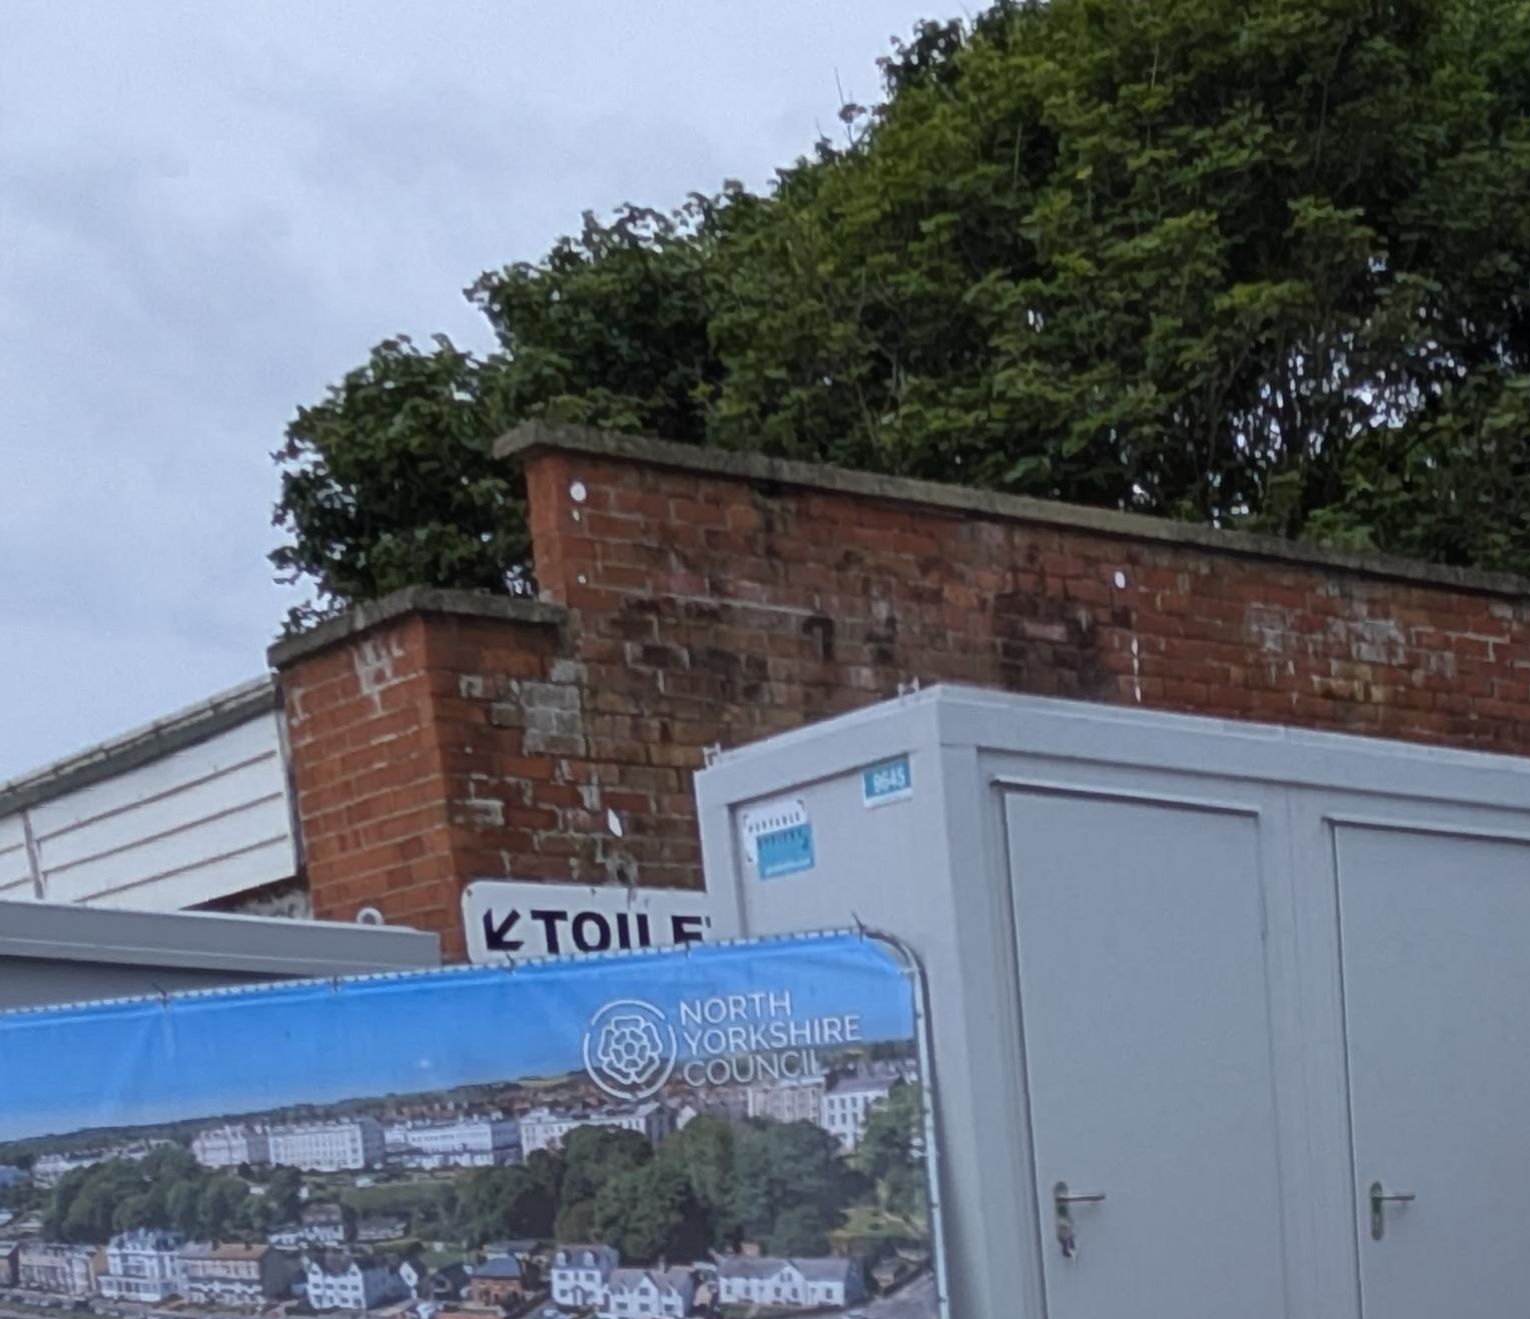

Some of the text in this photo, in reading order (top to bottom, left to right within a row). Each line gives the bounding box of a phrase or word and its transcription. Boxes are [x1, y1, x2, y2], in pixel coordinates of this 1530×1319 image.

[873, 766, 905, 793] 9645
[680, 990, 791, 1025] NORTH
[683, 1015, 862, 1056] YORKSHIRE
[684, 1049, 828, 1086] COUNCIL
